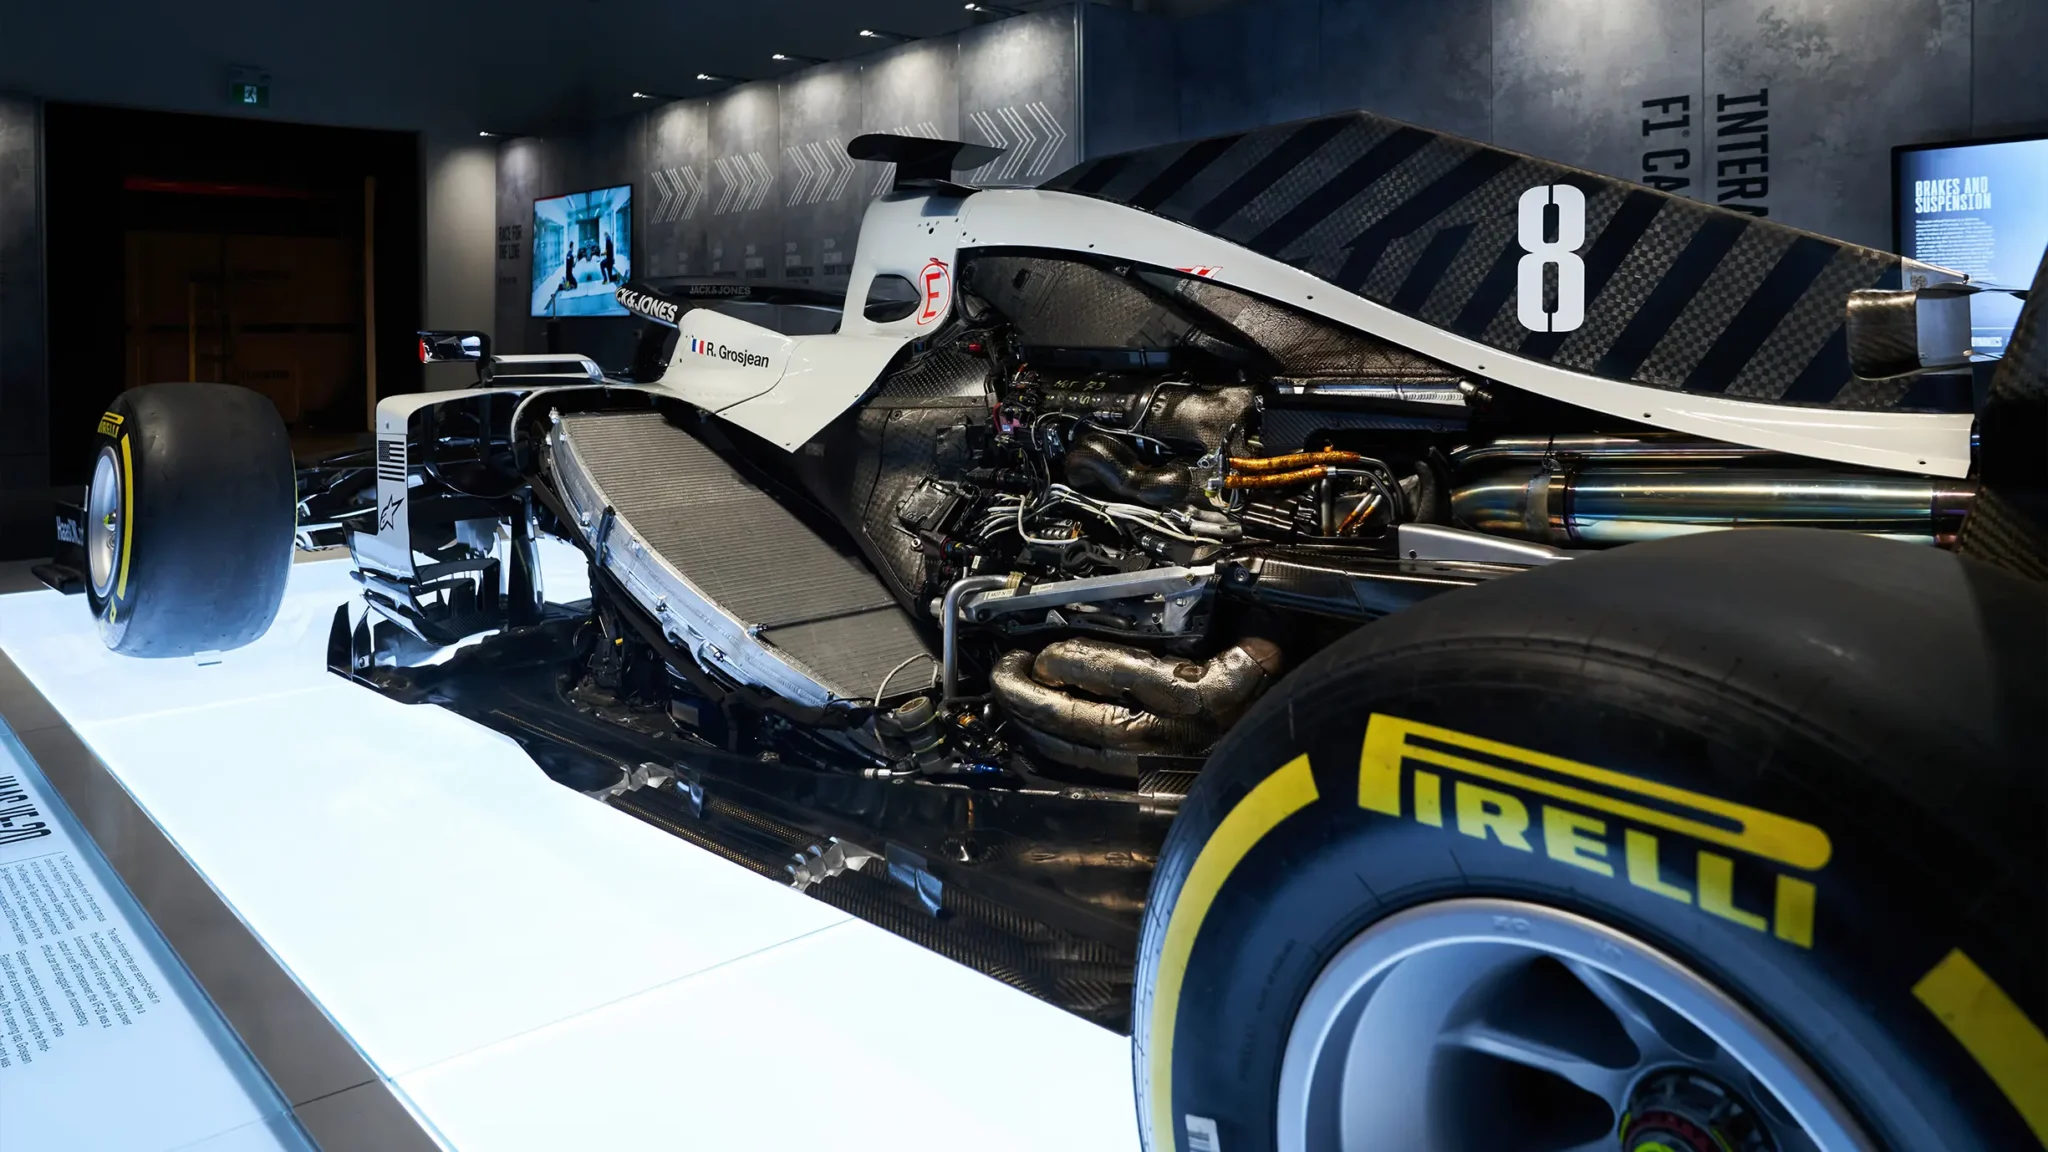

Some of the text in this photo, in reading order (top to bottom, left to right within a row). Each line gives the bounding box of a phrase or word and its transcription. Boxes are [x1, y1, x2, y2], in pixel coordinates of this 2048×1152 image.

[1642, 148, 1690, 200] CA
[1915, 176, 1989, 198] BRAKES AND
[1915, 193, 1992, 214] SUSPENSION
[1517, 183, 1586, 333] 8
[690, 285, 751, 295] JACK&JONES
[706, 342, 770, 368] R. Grosjean
[98, 411, 124, 438] PIRELLI
[1356, 711, 1832, 949] PIRELLI
